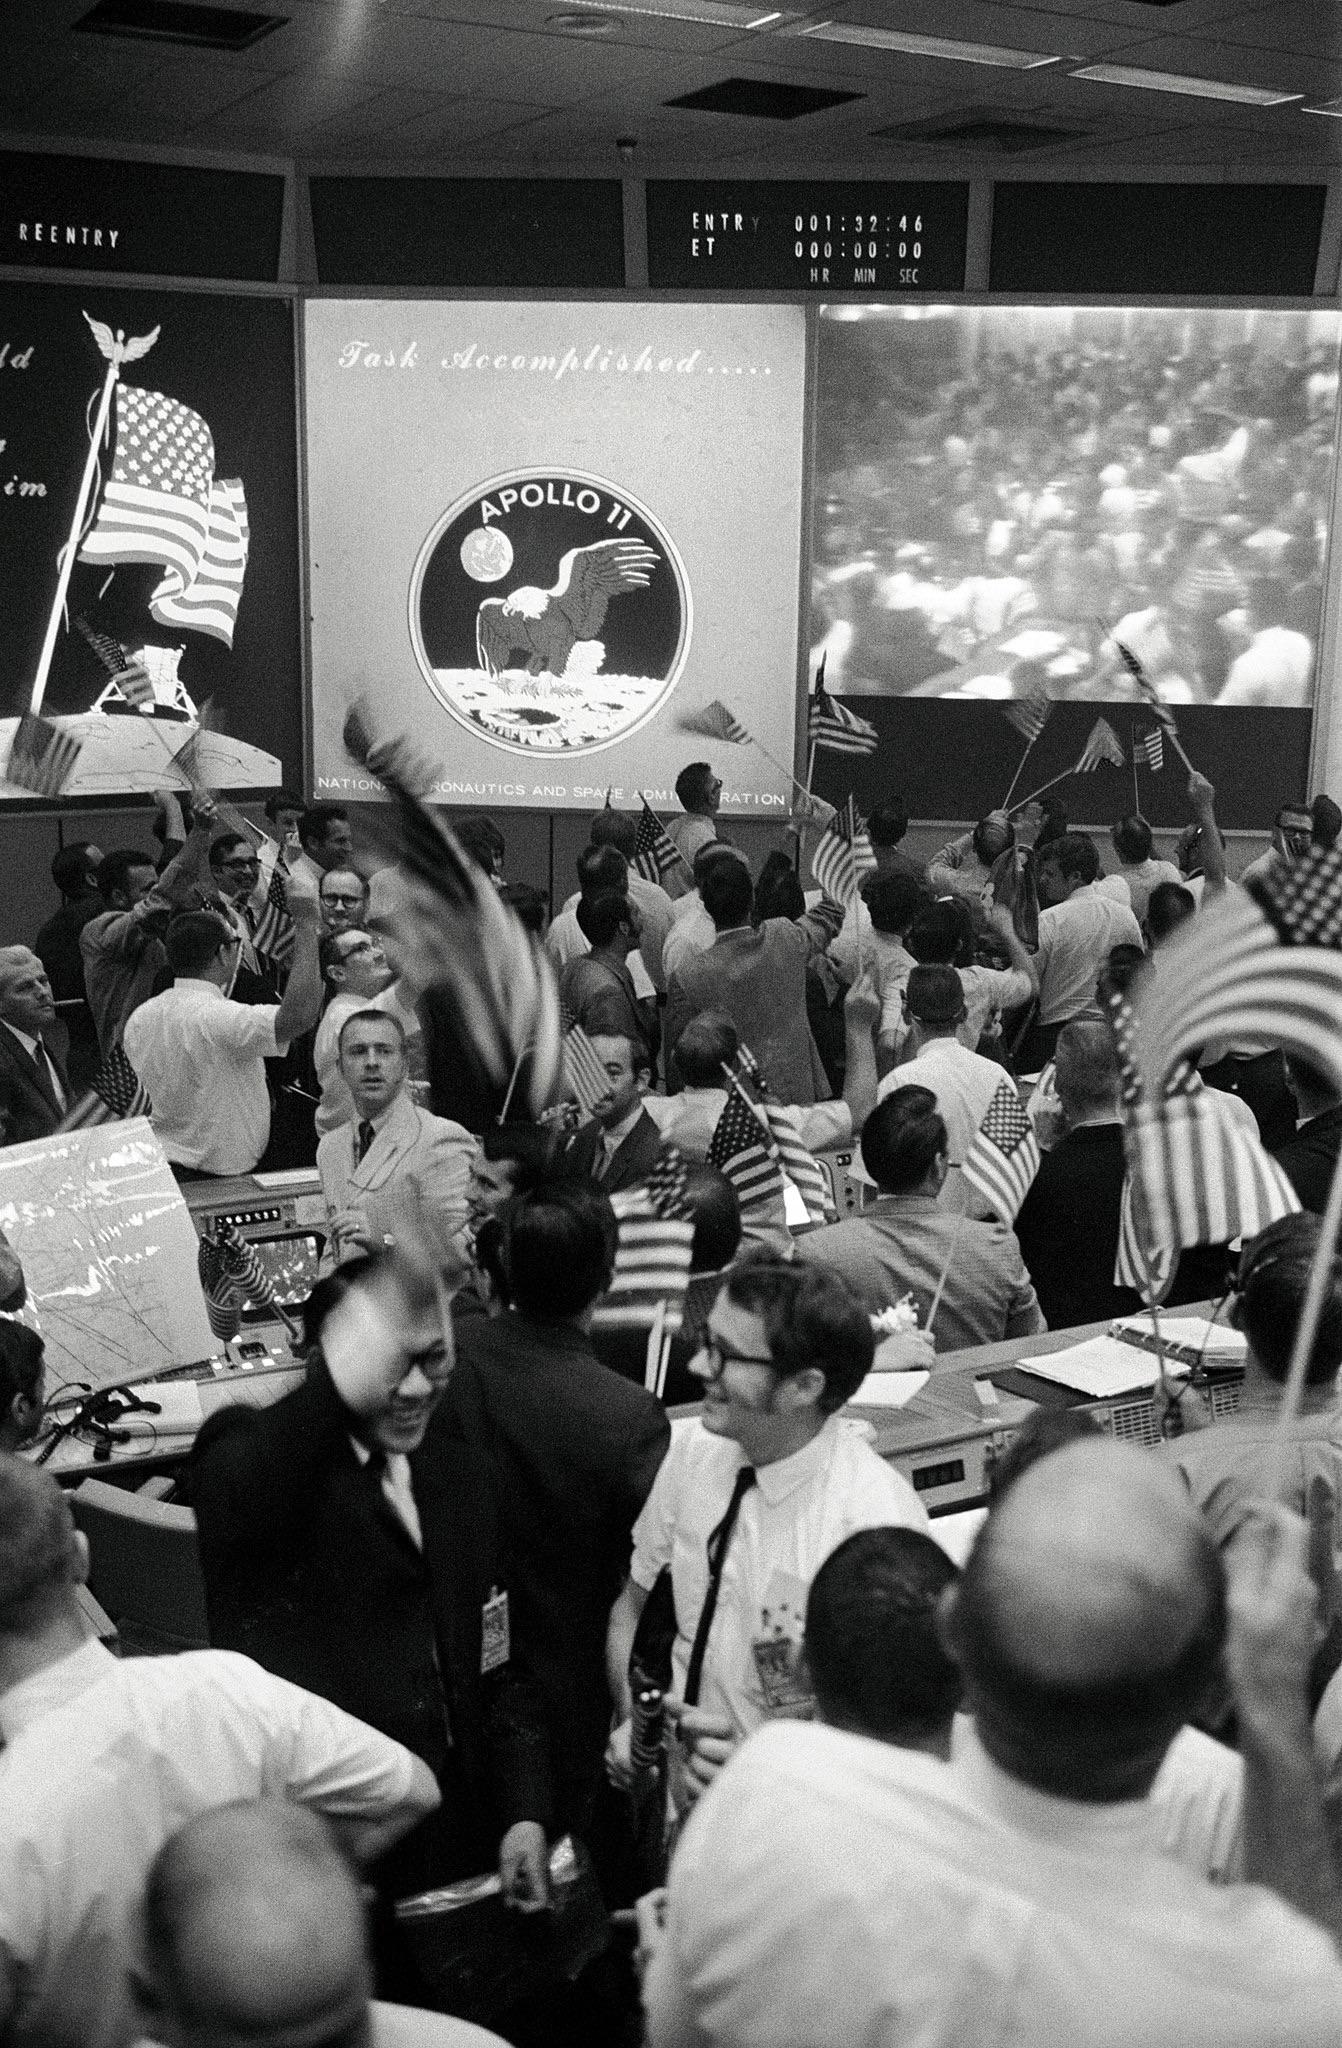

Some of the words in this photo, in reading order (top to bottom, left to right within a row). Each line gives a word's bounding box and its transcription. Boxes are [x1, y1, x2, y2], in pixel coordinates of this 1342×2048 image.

[795, 214, 923, 233] 001:32:46
[19, 222, 119, 249] REENTRY
[692, 237, 715, 257] ET
[795, 241, 922, 259] 000:00:00
[810, 267, 830, 283] HR
[854, 267, 876, 284] MIN
[899, 267, 919, 284] SEC
[338, 341, 418, 369] Task
[480, 482, 601, 524] APOLLO
[606, 501, 633, 531] 11
[532, 785, 566, 798] AND
[573, 786, 624, 800] SPACE
[631, 789, 786, 806] ADMIRATION
